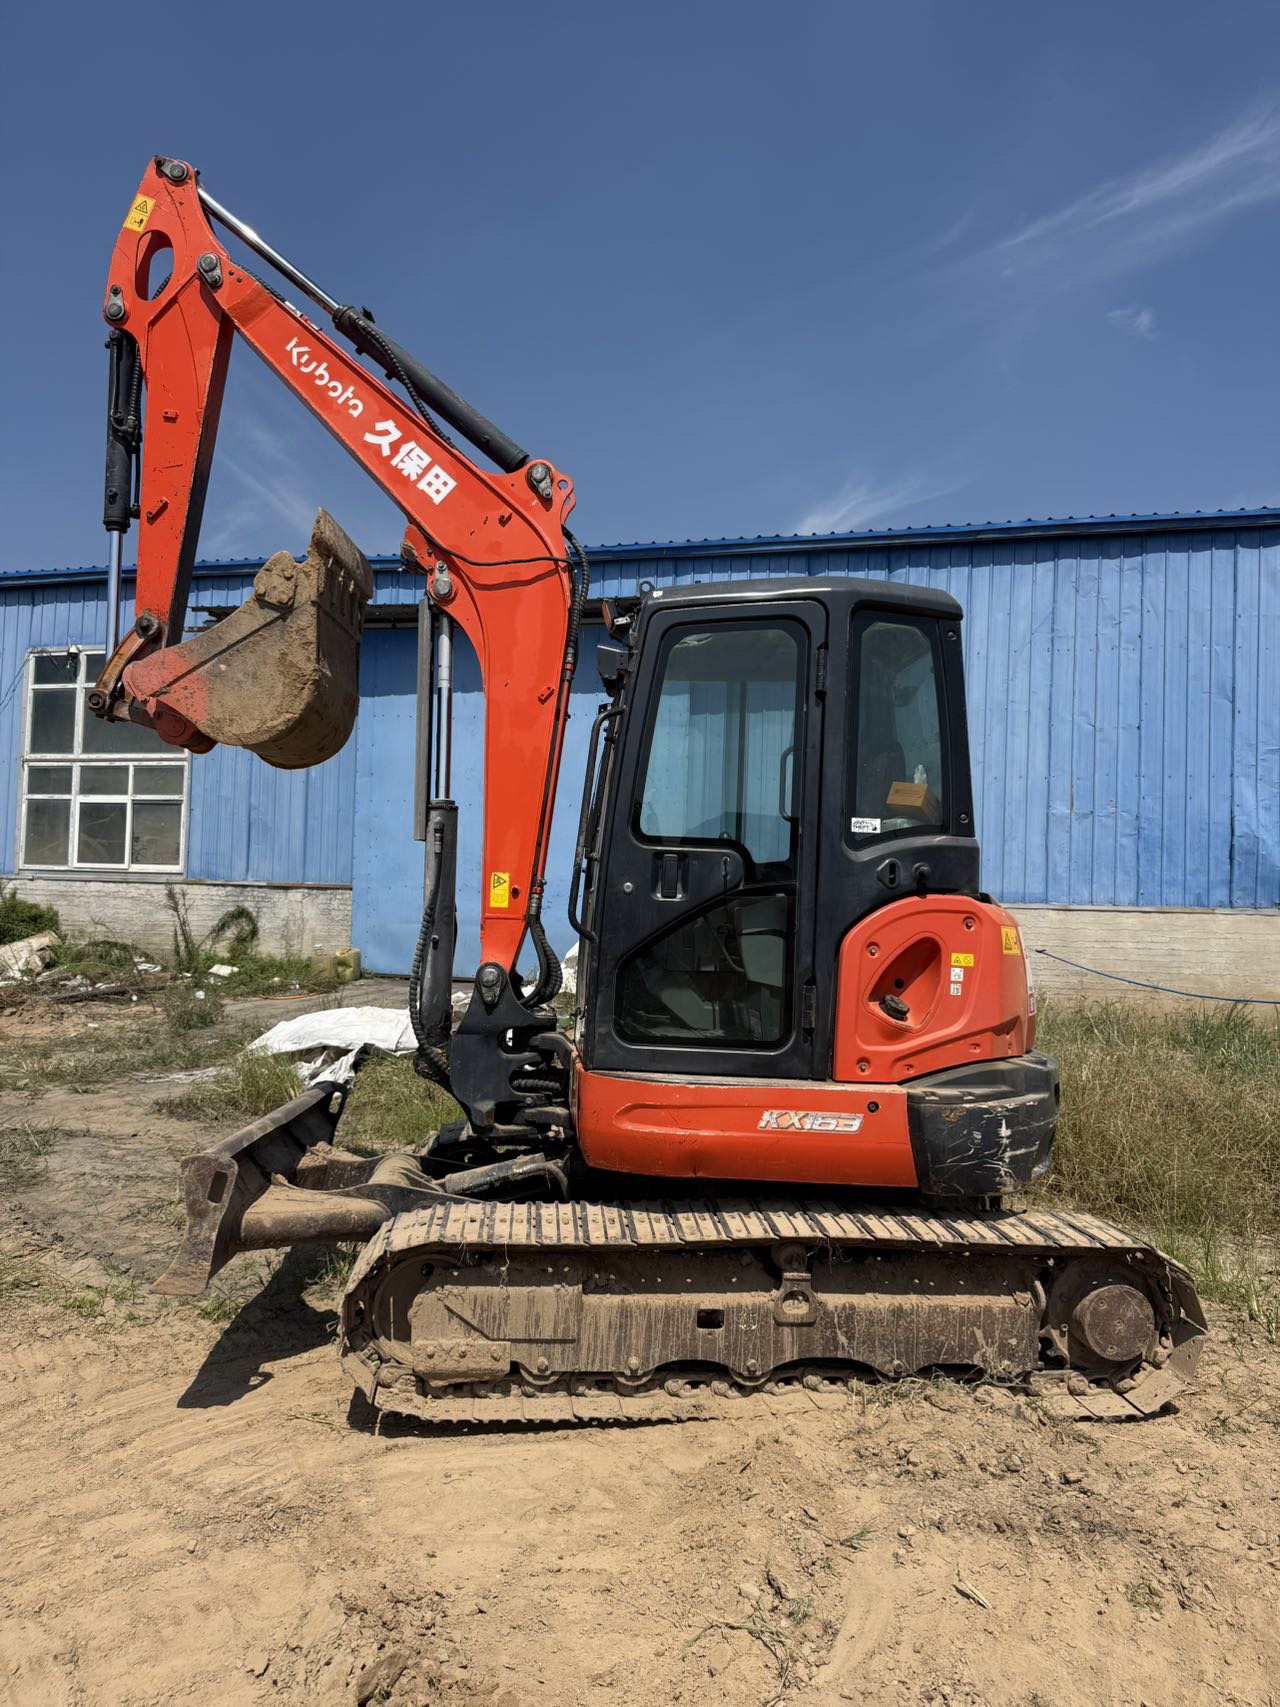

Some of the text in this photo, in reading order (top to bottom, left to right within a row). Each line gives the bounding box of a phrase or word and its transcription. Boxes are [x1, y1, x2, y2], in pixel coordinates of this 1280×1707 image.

[285, 337, 364, 418] Kubota
[363, 419, 457, 505] 久保田
